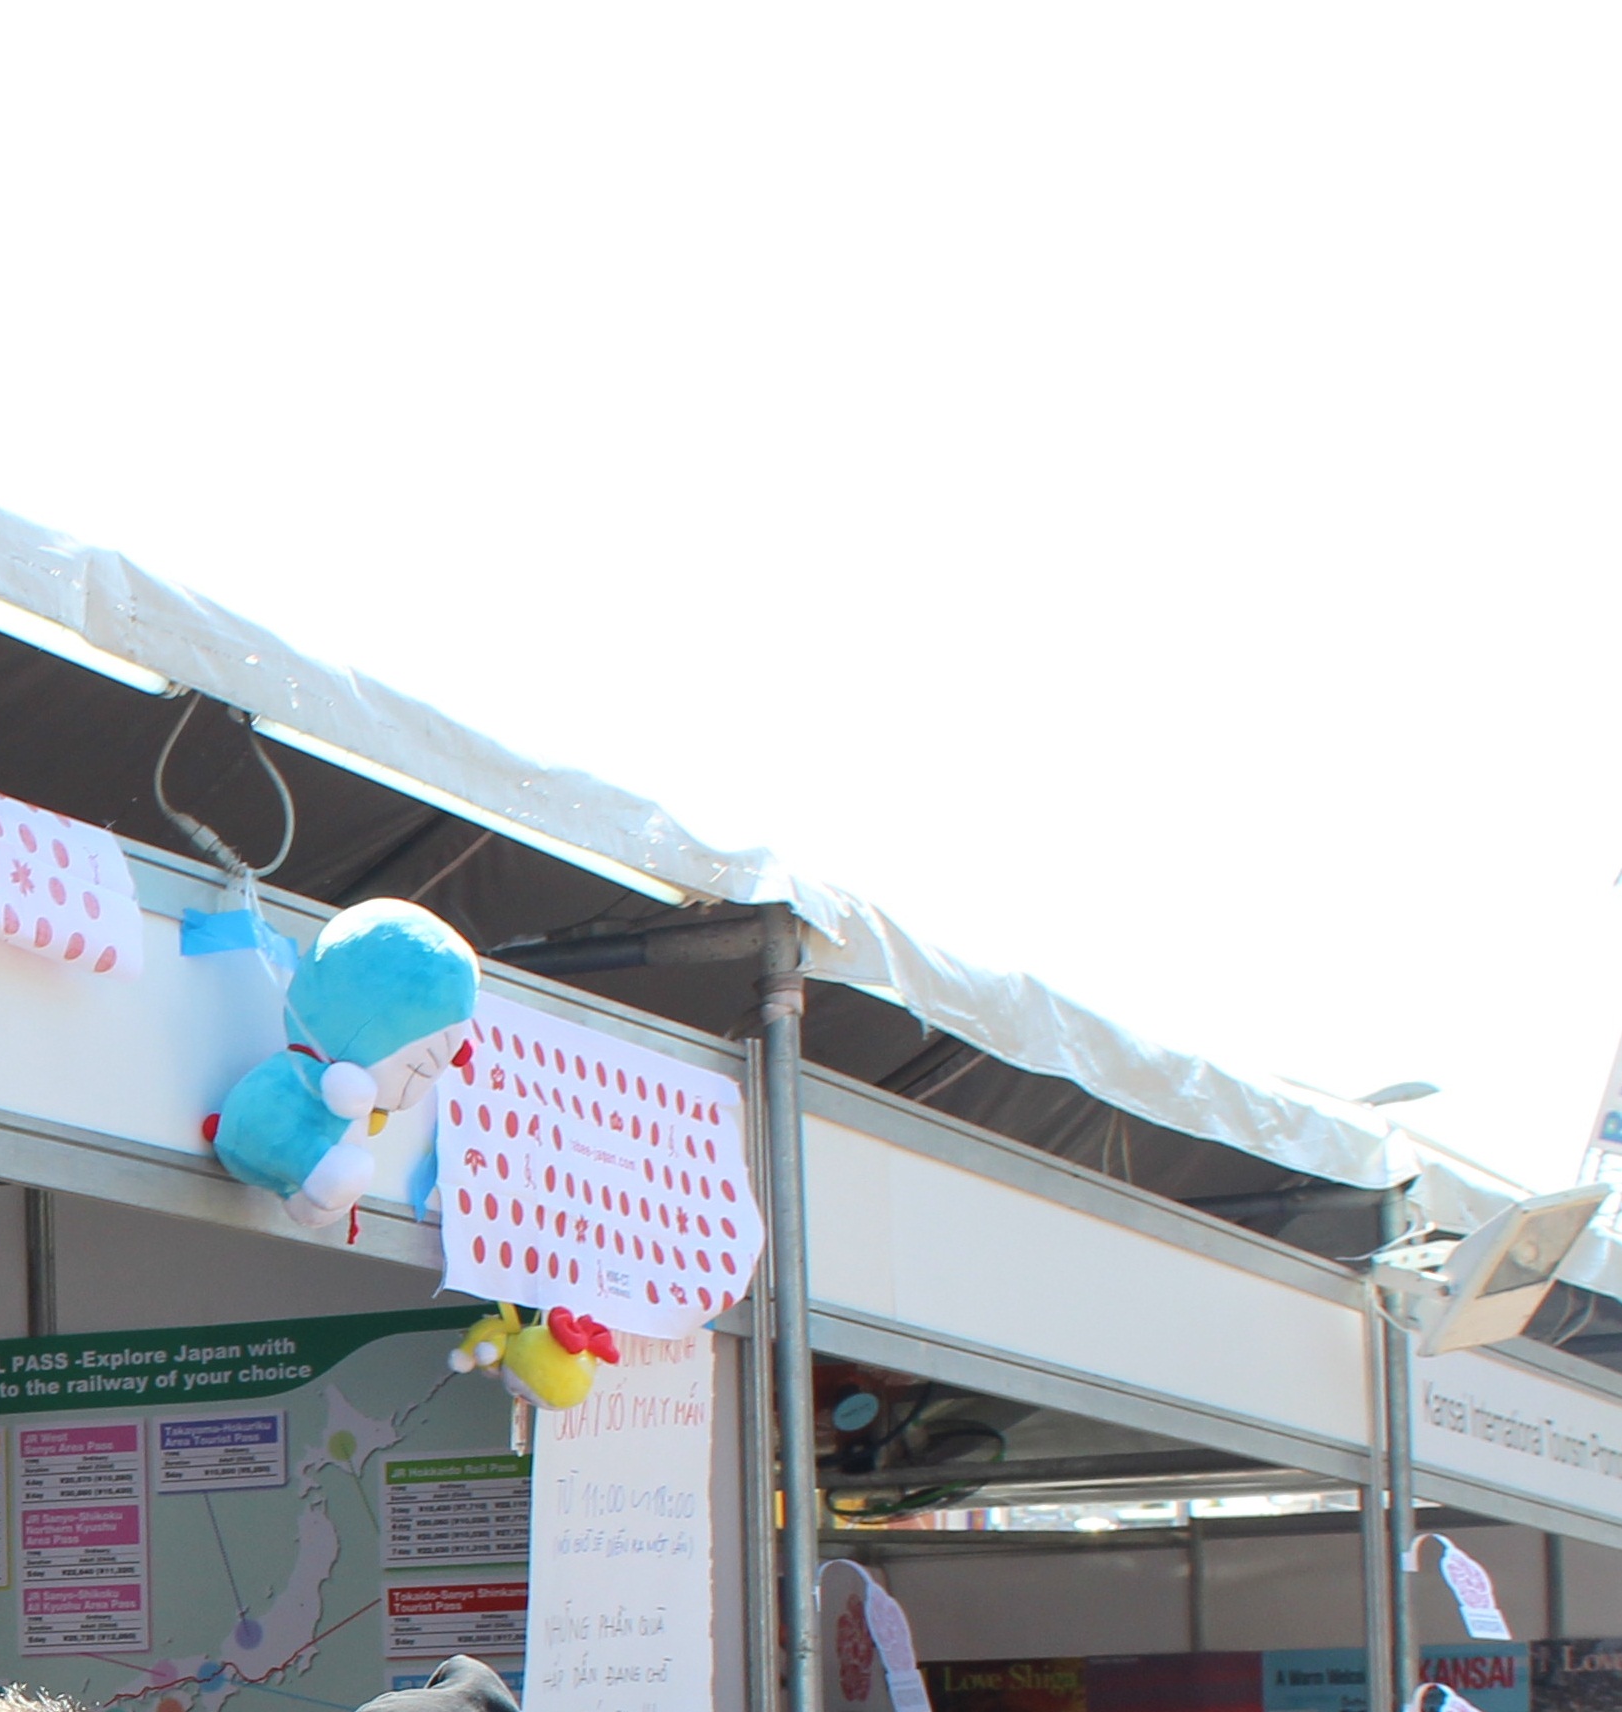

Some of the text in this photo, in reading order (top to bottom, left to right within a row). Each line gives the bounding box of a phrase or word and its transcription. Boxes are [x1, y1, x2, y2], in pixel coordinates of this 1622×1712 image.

[12, 1352, 68, 1373] PASS
[74, 1346, 168, 1374] -Explore
[173, 1342, 241, 1366] Japan
[247, 1337, 296, 1358] with
[0, 1380, 20, 1398] to
[26, 1377, 61, 1396] the
[67, 1371, 151, 1394] railway
[156, 1368, 178, 1388] of
[183, 1369, 232, 1387] your
[238, 1361, 313, 1383] choice
[632, 1395, 671, 1429] MAY
[1422, 1379, 1590, 1470] Kansai International Tourism
[23, 1431, 69, 1444] JR West
[164, 1433, 261, 1447] Area Tourist Pass
[59, 1441, 85, 1451] Area
[87, 1440, 114, 1451] Pass
[464, 1464, 487, 1474] Rail
[489, 1463, 518, 1473] Pass
[26, 1514, 40, 1525] JR
[26, 1520, 117, 1535] Northern Kyushu
[26, 1534, 79, 1545] Area Pass
[27, 1591, 42, 1601] JR
[43, 1600, 83, 1613] Kyushu
[84, 1600, 108, 1610] Area
[110, 1599, 137, 1609] Pass
[393, 1601, 462, 1613] Tourist Pass
[944, 1664, 1079, 1696] Love Shiga
[1419, 1656, 1516, 1690] KANSAI
